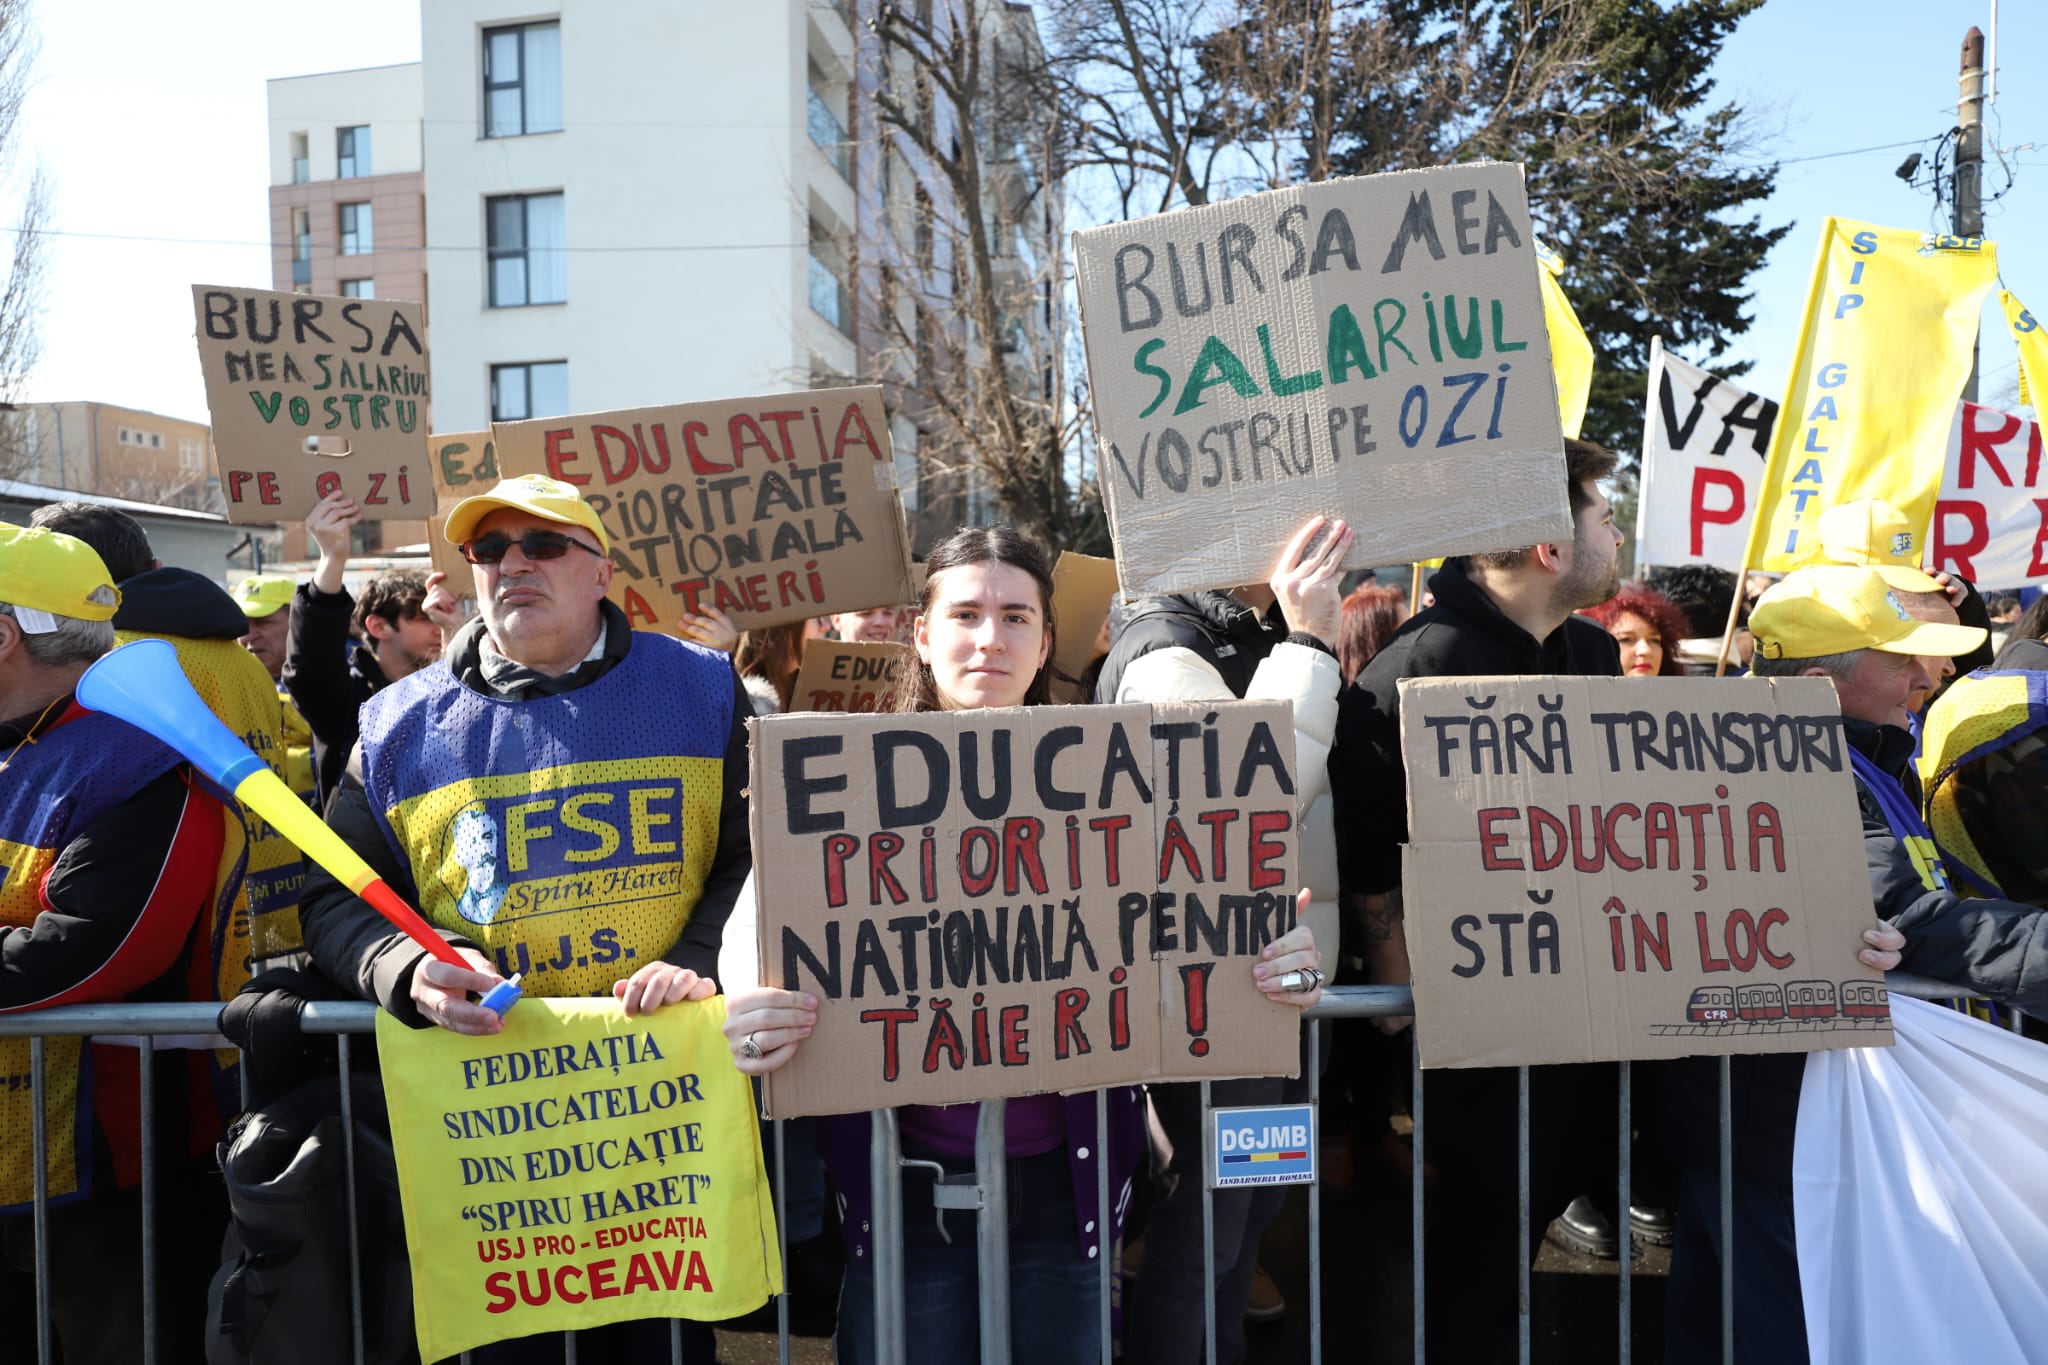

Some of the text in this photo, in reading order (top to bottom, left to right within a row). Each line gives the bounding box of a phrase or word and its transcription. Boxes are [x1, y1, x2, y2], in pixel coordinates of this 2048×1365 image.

[1114, 189, 1522, 334] BURSA MEA
[1834, 231, 1878, 319] SIP
[204, 291, 424, 355] BURSA
[225, 350, 307, 384] MEA
[250, 391, 418, 433] VOSTRU
[1109, 409, 1314, 500] VOSTRU
[1327, 404, 1377, 463] PE
[228, 470, 281, 505] PE
[1424, 694, 1844, 777] FĂRĂ TRANSPORT
[505, 787, 677, 873] FSE
[510, 866, 679, 912] Spiru Haret
[495, 928, 636, 978] U.J.S.
[1118, 891, 1297, 966] PENTRU
[1450, 890, 1796, 977] STĂ ÎN LOC
[1704, 1010, 1728, 1020] CFR
[460, 1031, 665, 1089] FEDERAȚIA
[443, 1073, 705, 1140] SINDICATELOR
[1221, 1125, 1307, 1151] DGJMB
[458, 1122, 705, 1186] DIN EDUCAȚIE
[477, 1237, 526, 1264] USJ
[534, 1233, 576, 1257] PRO
[595, 1216, 708, 1250] EDUCAȚIA
[484, 1249, 714, 1315] SUCEAVA
